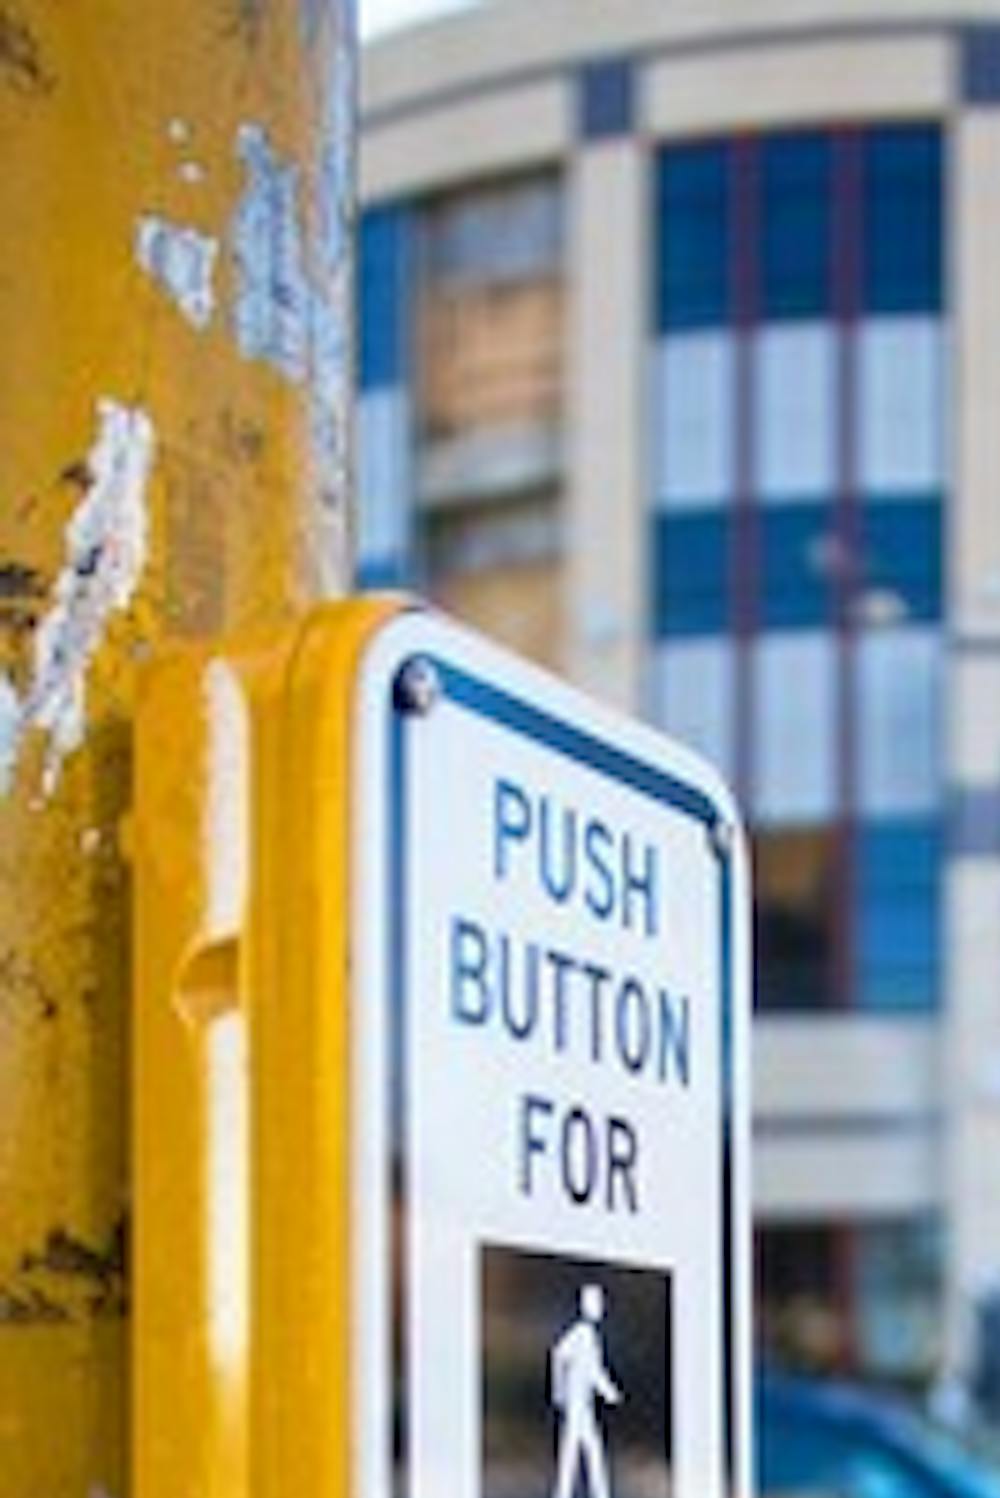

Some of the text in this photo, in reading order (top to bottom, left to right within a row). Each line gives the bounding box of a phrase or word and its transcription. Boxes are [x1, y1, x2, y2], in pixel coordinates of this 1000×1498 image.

[495, 779, 657, 936] PUSH
[450, 916, 690, 1088] BUTTON
[520, 1095, 638, 1214] FOR
